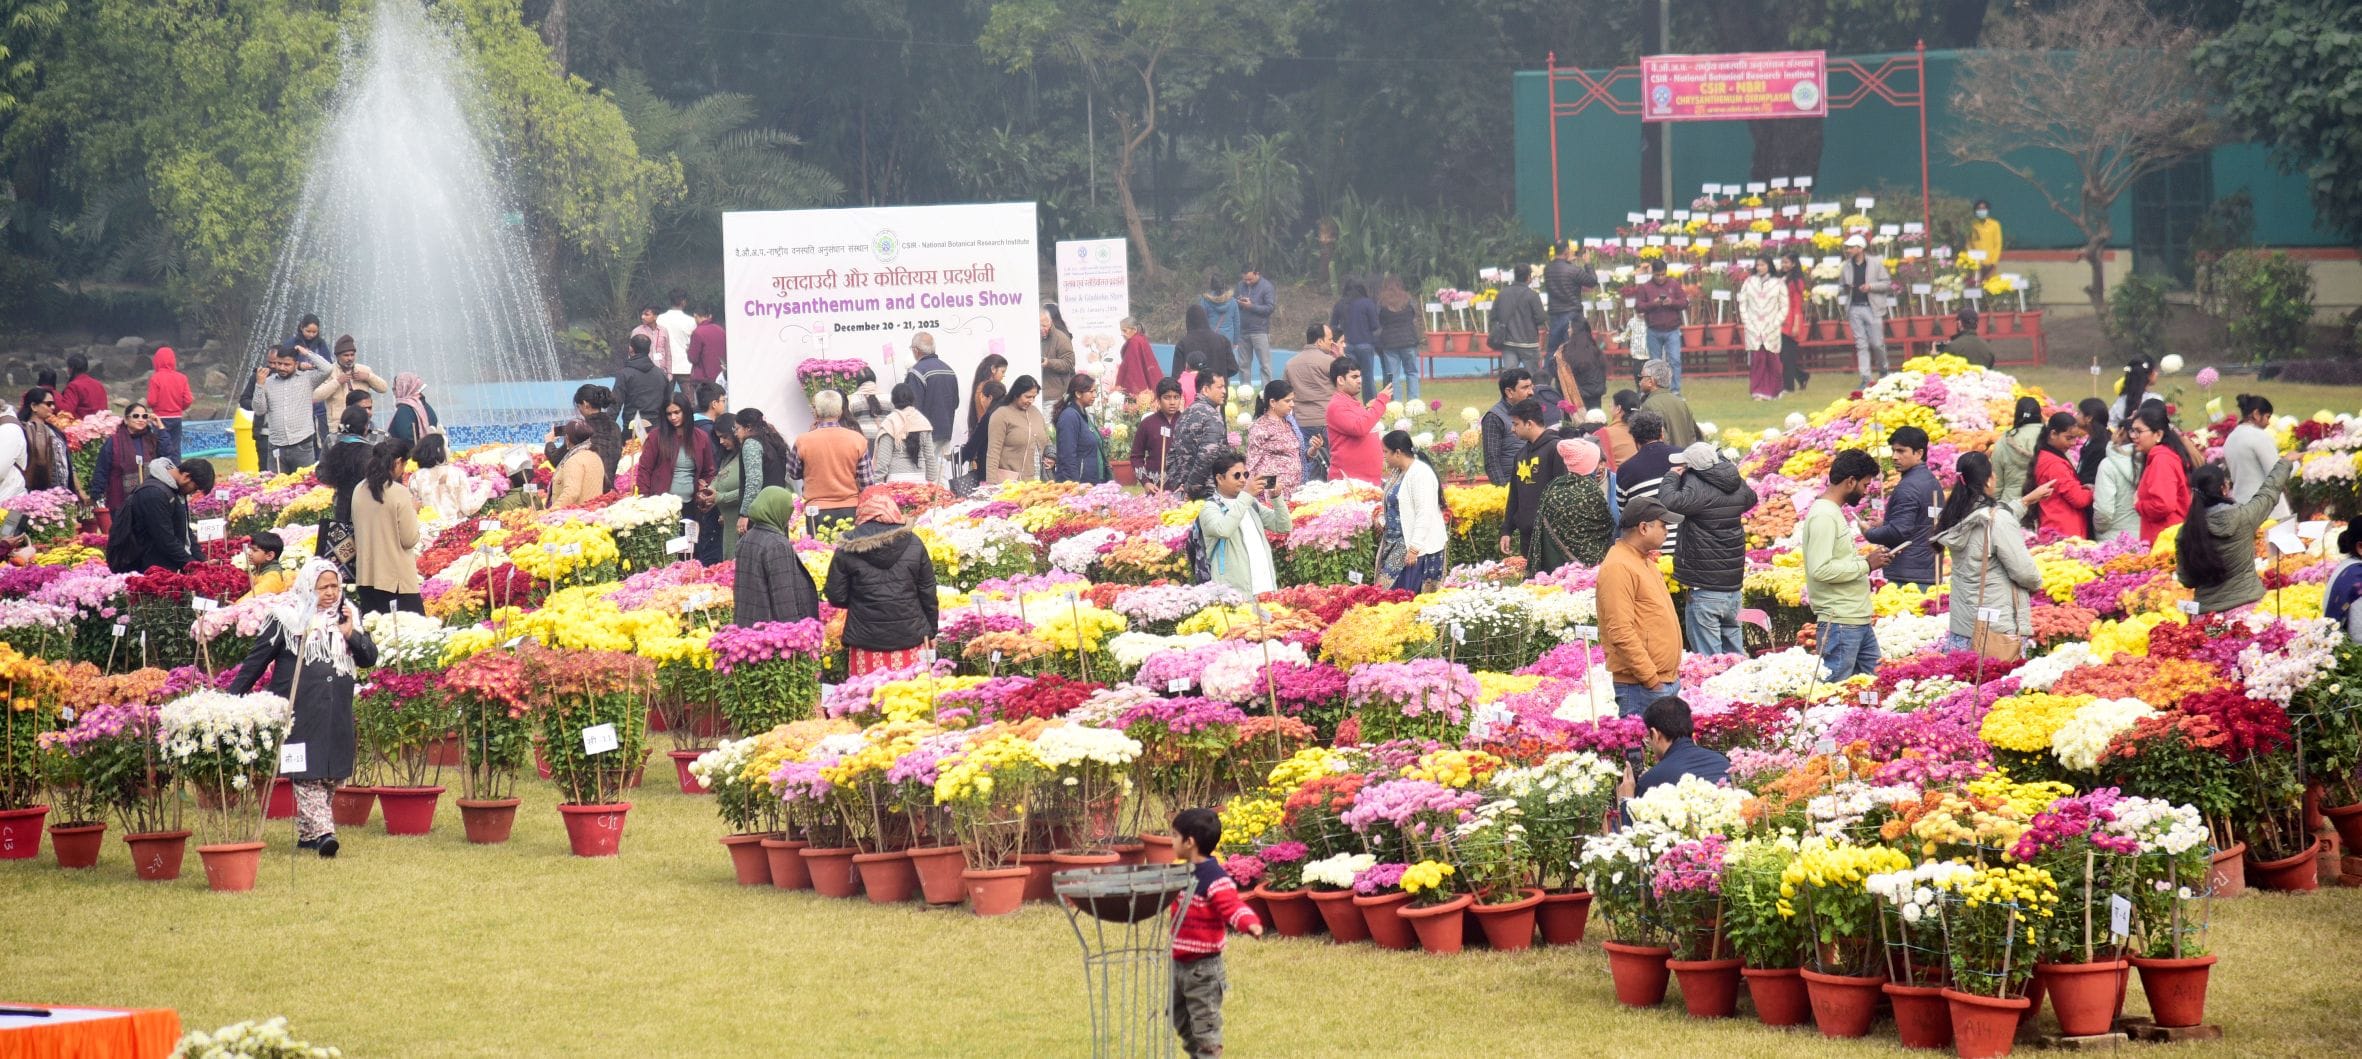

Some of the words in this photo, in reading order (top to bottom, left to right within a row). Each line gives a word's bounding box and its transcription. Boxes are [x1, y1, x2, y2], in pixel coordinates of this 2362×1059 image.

[1651, 74, 1668, 83] CSIR
[1674, 73, 1706, 82] National
[1709, 72, 1744, 81] Botanical
[1746, 71, 1780, 80] Research
[1783, 70, 1816, 79] Institute
[1700, 82, 1726, 95] CSIR
[1736, 80, 1767, 93] NBRI
[901, 242, 917, 250] CSIR
[922, 241, 947, 249] National
[948, 240, 976, 248] Botanical
[977, 239, 1005, 247] Research
[1005, 238, 1030, 246] Institute
[772, 268, 837, 298] गुलदाउदी
[843, 267, 869, 287] और
[874, 265, 938, 287] कोलियस
[943, 262, 995, 286] प्रदर्शनी
[744, 297, 880, 319] Chrysanthemum
[885, 293, 915, 310] and
[920, 291, 974, 309] Coleus
[978, 289, 1022, 307] Show
[834, 322, 880, 332] December
[882, 321, 894, 330] 20
[903, 321, 916, 331] 21,
[918, 320, 940, 329] 2025
